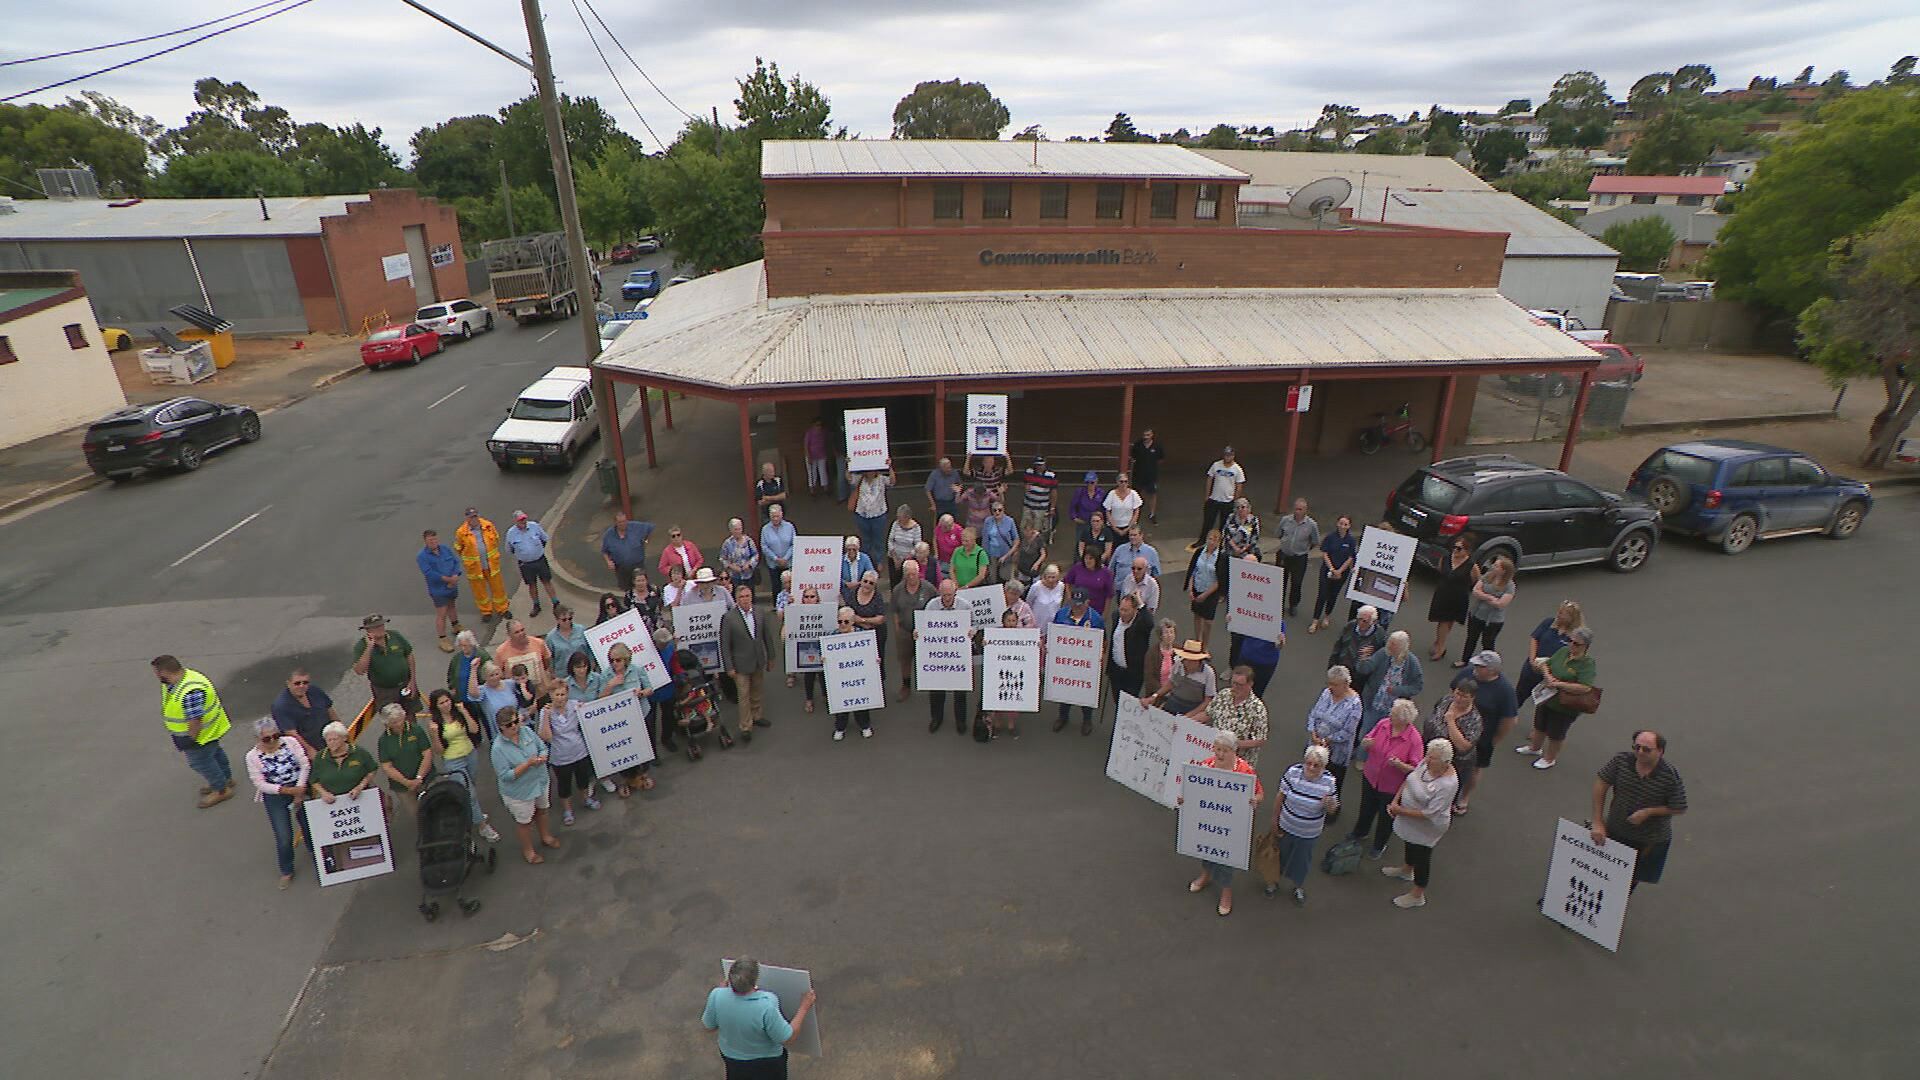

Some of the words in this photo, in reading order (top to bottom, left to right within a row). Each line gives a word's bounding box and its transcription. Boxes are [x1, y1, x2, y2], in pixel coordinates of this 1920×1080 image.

[979, 249, 1121, 266] Commonwealth
[1122, 248, 1160, 265] Bank
[804, 547, 832, 555] BANKS
[1376, 541, 1399, 553] SAVE
[1375, 551, 1395, 562] OUR
[809, 565, 825, 573] ARE
[1370, 560, 1395, 572] BANK
[1240, 571, 1271, 584] BANKS
[1247, 591, 1264, 602] ARE
[972, 598, 991, 608] SAVE
[974, 608, 992, 617] OUR
[1236, 607, 1274, 622] BULLIES!
[688, 614, 712, 624] STOP
[800, 615, 823, 623] STOP
[689, 624, 713, 632] BANK
[599, 623, 636, 646] PEOPLE
[680, 631, 720, 642] CLOSURE
[923, 636, 949, 644] HAVE
[950, 636, 966, 644] NO
[826, 642, 847, 651] OUR
[848, 639, 872, 648] LAST
[1056, 635, 1094, 648] PEOPLE
[928, 651, 962, 659] MORAL
[838, 660, 864, 669] BANK
[922, 664, 966, 672] COMPASS
[1055, 656, 1092, 669] BEFORE
[841, 678, 866, 688] MUST
[1052, 676, 1092, 689] PROFITS
[843, 697, 870, 707] STAY!
[584, 707, 607, 719] OUR
[608, 698, 632, 712] LAST
[600, 720, 629, 734] BANK
[606, 736, 632, 752] MUST
[610, 753, 639, 768] STAY!
[1188, 774, 1214, 787] OUR
[1217, 780, 1248, 792] LAST
[329, 805, 360, 818] SAVE
[1200, 800, 1232, 814] BANK
[334, 816, 361, 828] OUR
[332, 825, 367, 840] BANK
[1198, 822, 1230, 836] MUST
[1196, 844, 1230, 858] STAY!
[1561, 834, 1630, 869] ACCESSIBILITY
[1570, 858, 1590, 872] FOR
[1592, 867, 1610, 881] ALL
